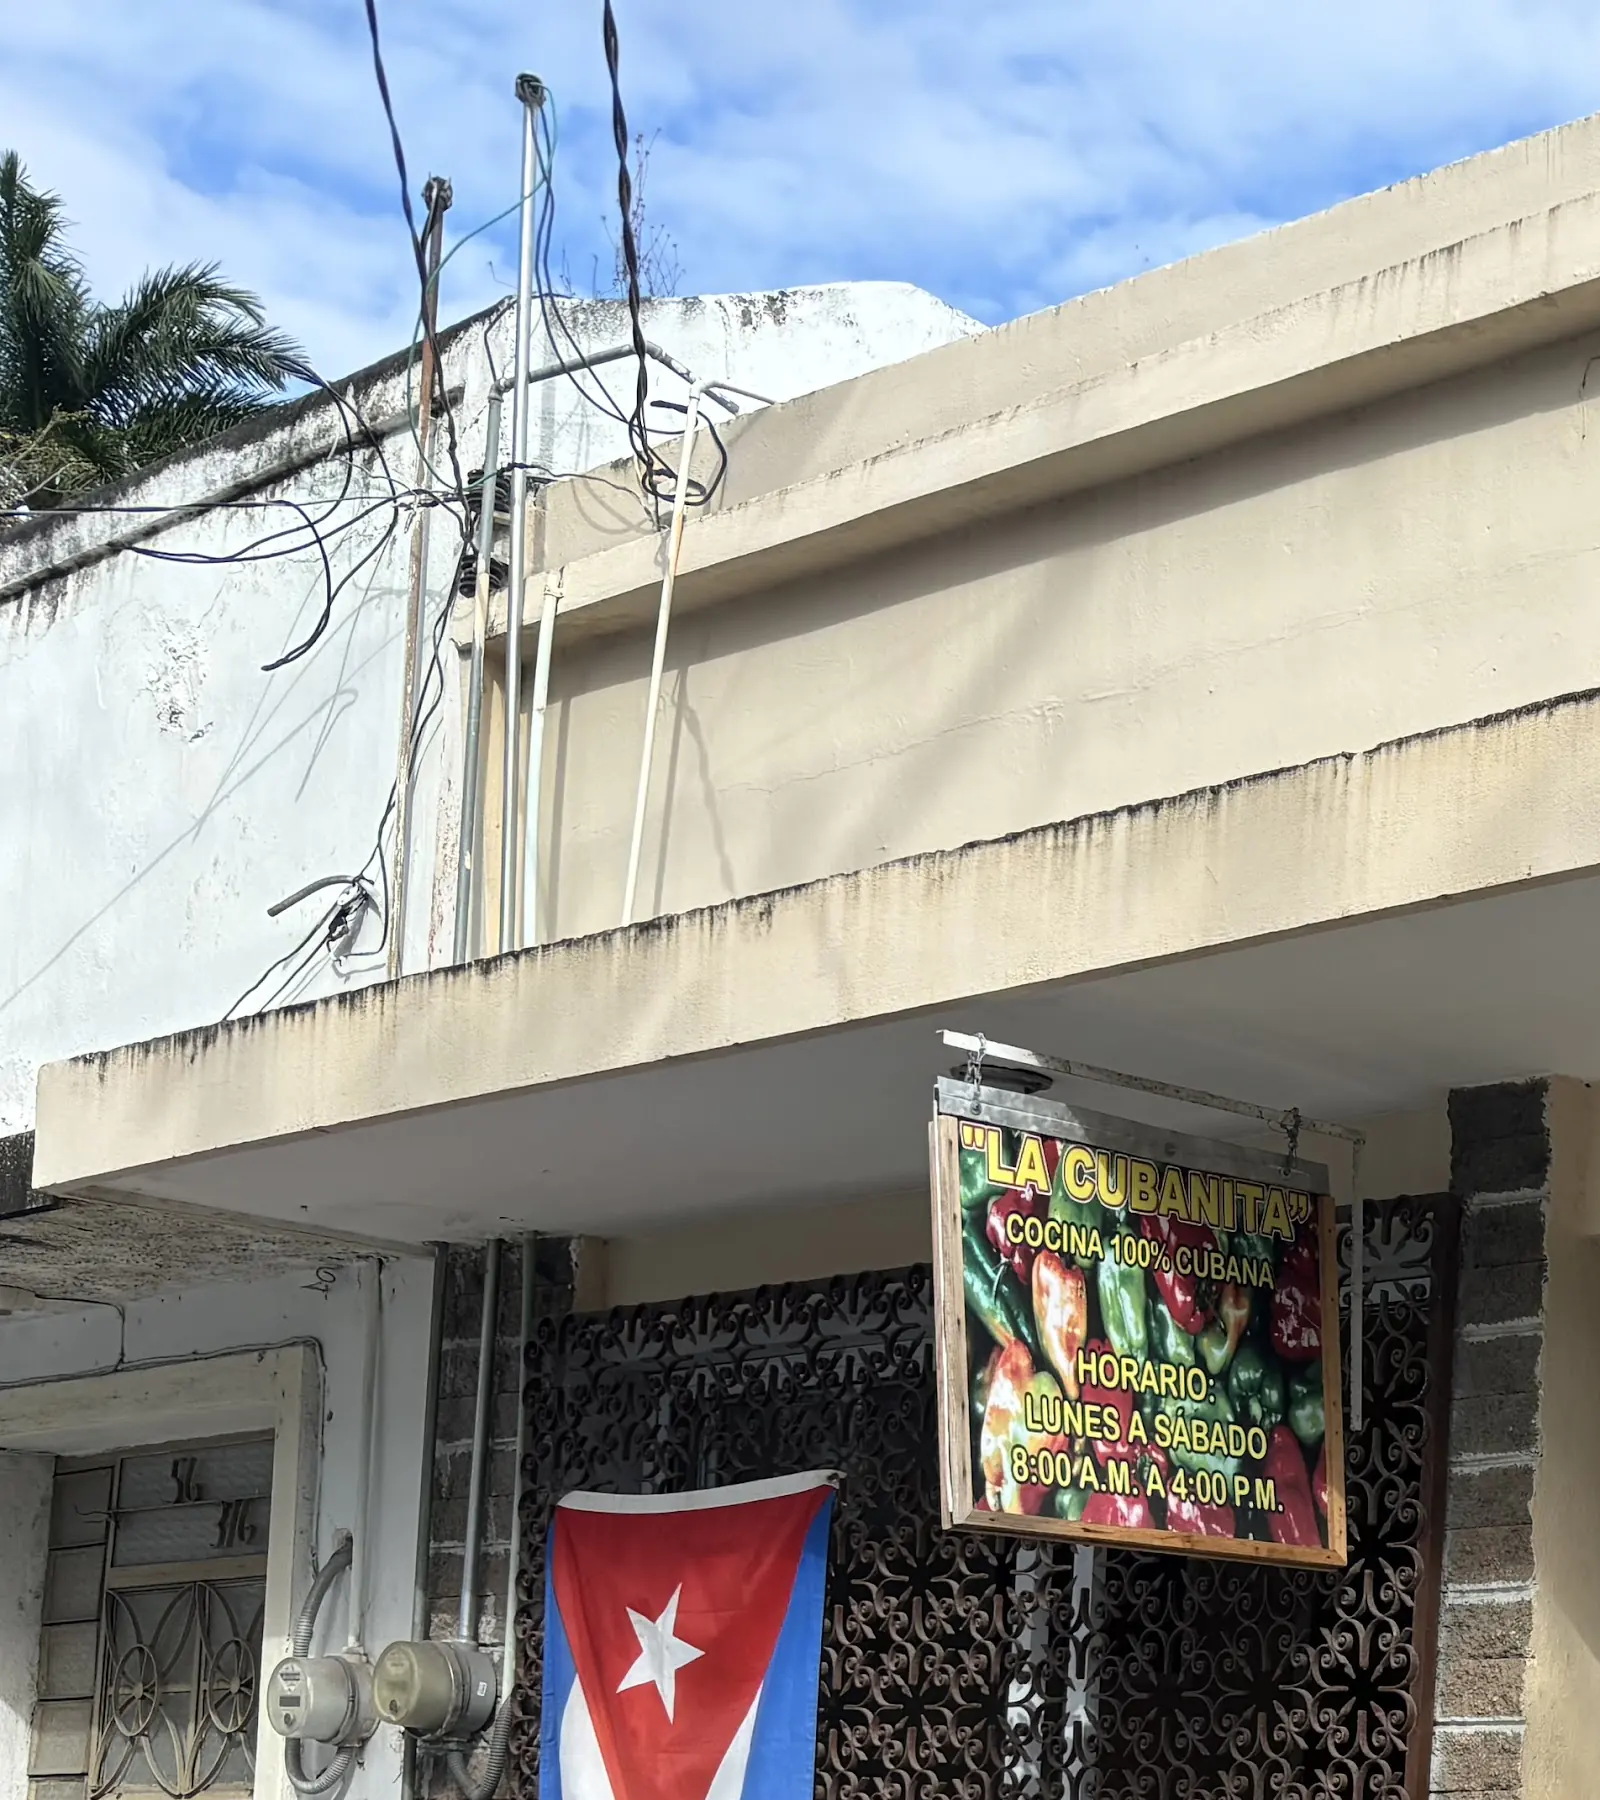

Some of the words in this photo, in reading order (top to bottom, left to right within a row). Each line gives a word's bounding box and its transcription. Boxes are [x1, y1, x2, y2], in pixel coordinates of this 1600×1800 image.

[1006, 1213, 1104, 1260] COCINA
[1110, 1232, 1171, 1272] 100%
[1176, 1250, 1275, 1290] CUBANA
[1077, 1349, 1216, 1403] HORARIO:
[1024, 1393, 1121, 1442] LUNES
[1127, 1410, 1148, 1446] A
[1154, 1407, 1267, 1460] SÁBADO
[1011, 1446, 1072, 1487] 8:00
[1079, 1455, 1139, 1496] A.M.
[1146, 1465, 1166, 1498] A
[1170, 1467, 1227, 1505] 4:00
[1233, 1475, 1285, 1512] P.M.
